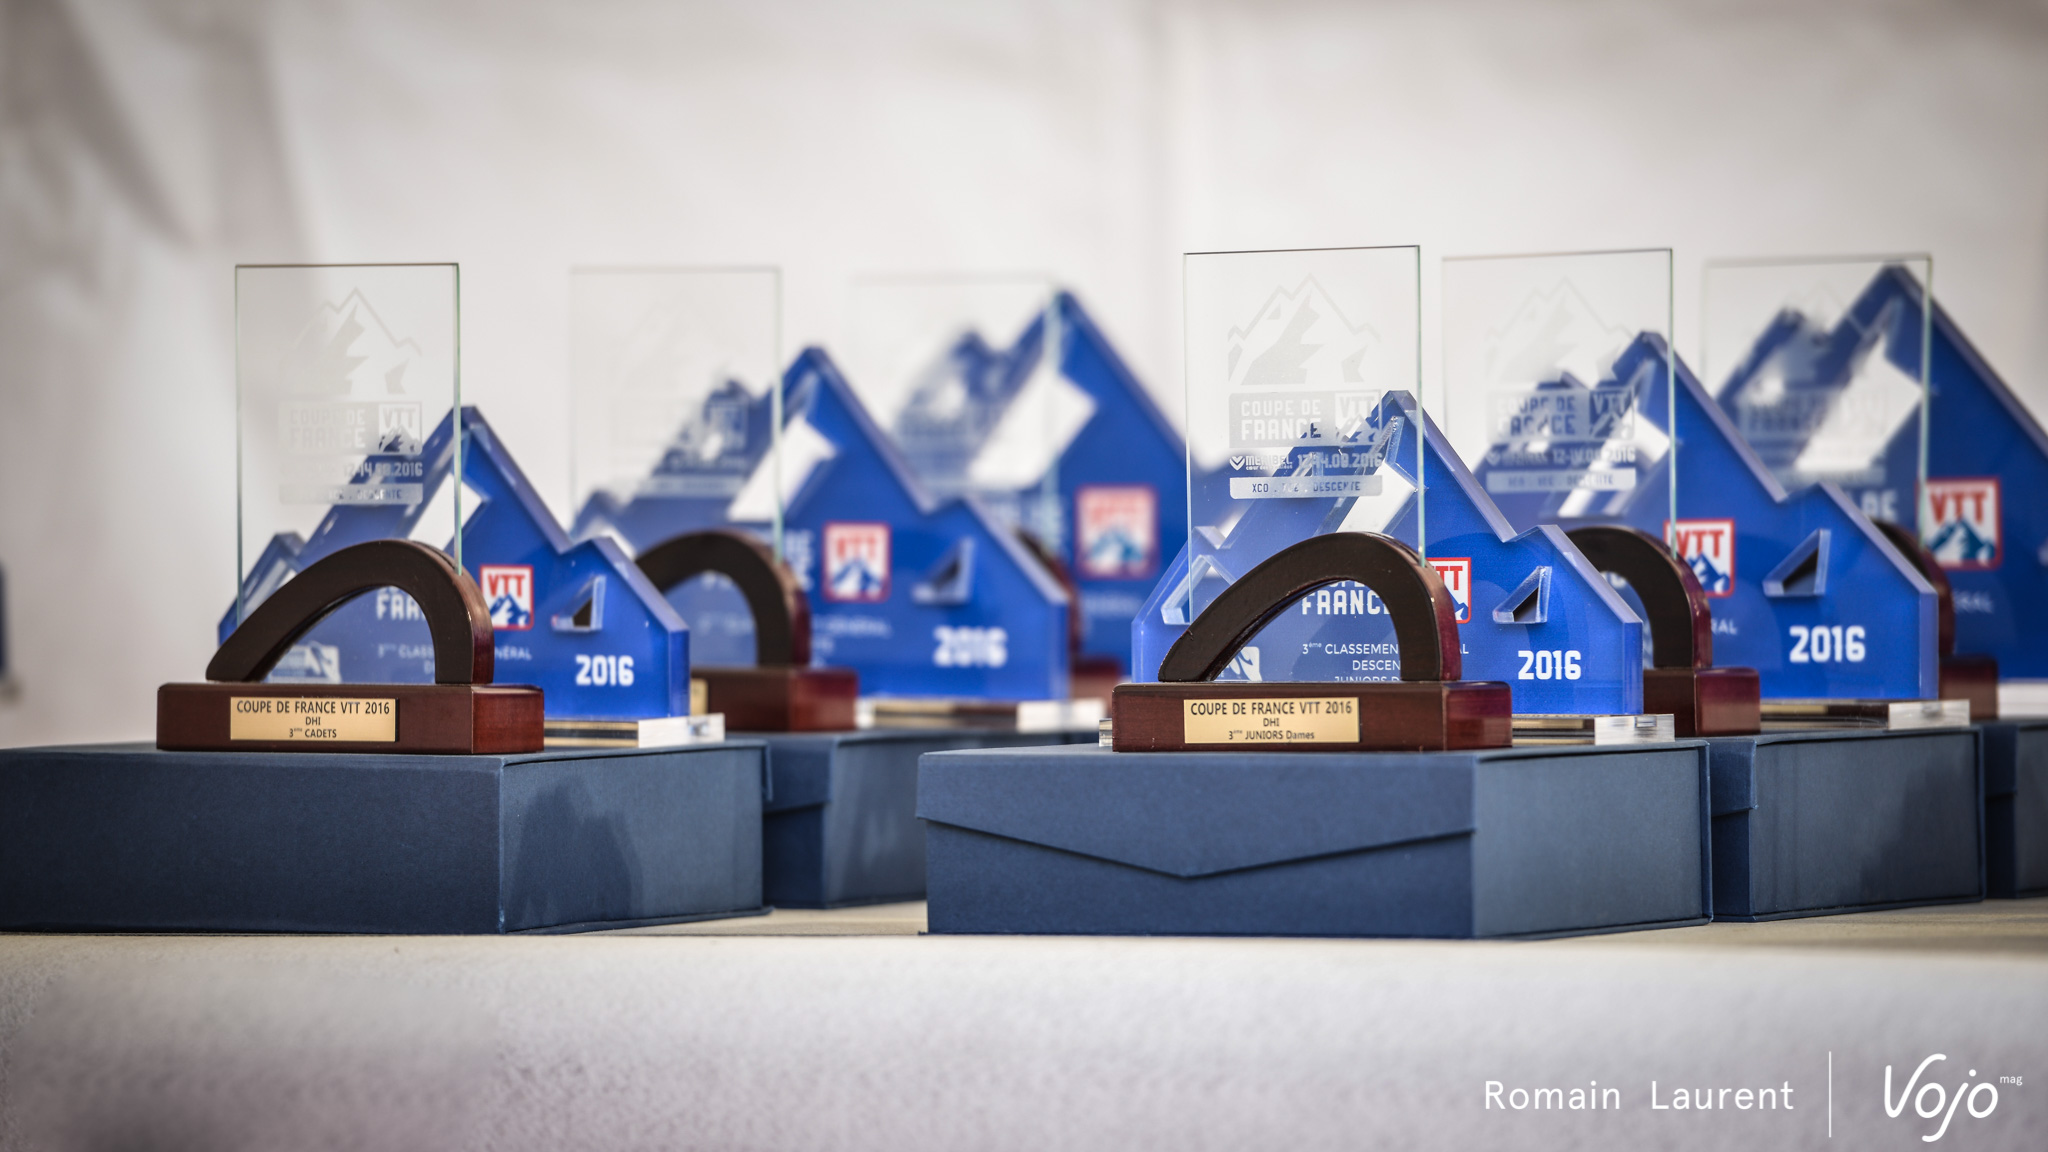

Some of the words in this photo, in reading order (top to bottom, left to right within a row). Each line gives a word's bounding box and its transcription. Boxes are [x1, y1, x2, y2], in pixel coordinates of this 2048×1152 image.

[347, 408, 366, 425] DE
[1241, 399, 1294, 417] COUPE
[1302, 399, 1322, 416] DE
[382, 408, 417, 429] VTT
[1241, 418, 1322, 440] FRANCE
[1252, 483, 1269, 493] XCO
[1929, 490, 1987, 526] VTT
[1675, 529, 1724, 558] VTT
[487, 573, 526, 598] VTT
[1324, 643, 1399, 655] CLASSEMEN
[1789, 625, 1866, 663] 2016
[575, 655, 635, 687] 2016
[1517, 650, 1582, 681] 2016
[236, 699, 272, 713] COUPE
[276, 700, 290, 713] DE
[294, 701, 336, 714] FRANCE
[341, 701, 361, 714] VTT
[365, 701, 390, 715] 2016
[1190, 702, 1227, 716] COUPE
[1232, 702, 1247, 715] DE
[1251, 701, 1295, 715] FRANCE
[1300, 701, 1320, 714] VTT
[1325, 701, 1352, 714] 2016
[305, 716, 321, 726] DHI
[1262, 717, 1280, 727] DHI
[304, 728, 337, 739] CADETS
[1245, 730, 1283, 740] JUNIORS
[1286, 730, 1315, 740] Dames
